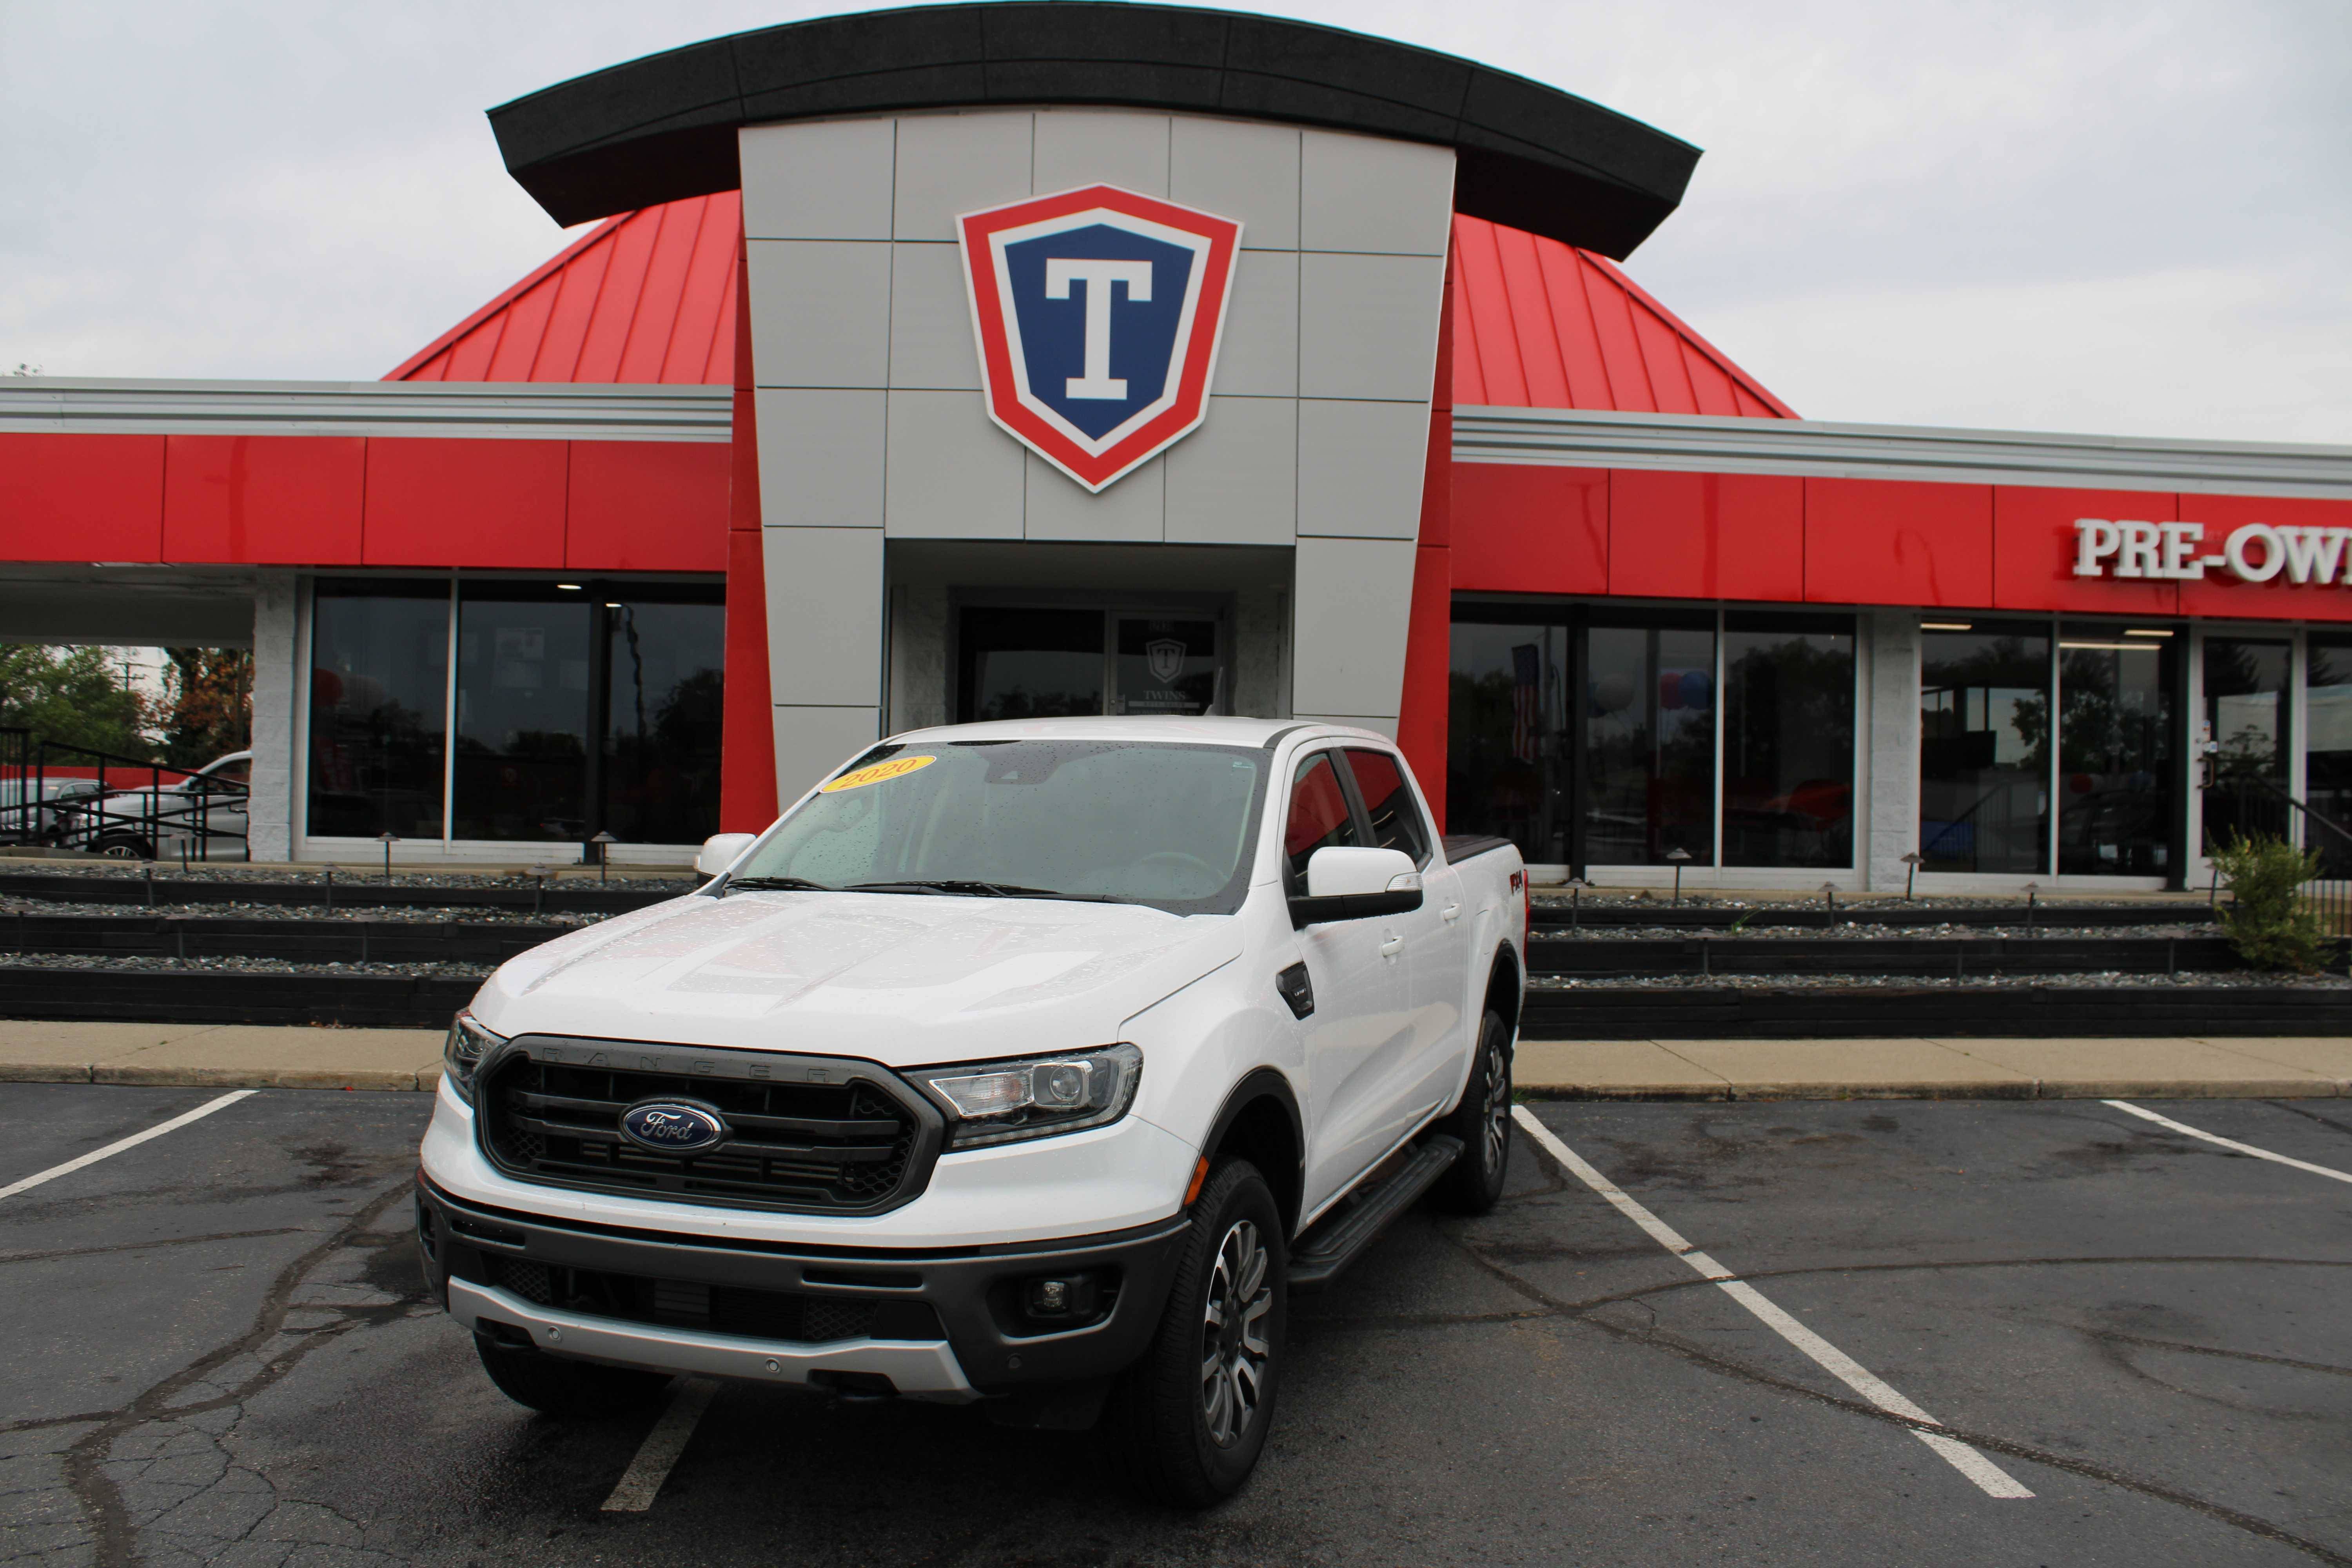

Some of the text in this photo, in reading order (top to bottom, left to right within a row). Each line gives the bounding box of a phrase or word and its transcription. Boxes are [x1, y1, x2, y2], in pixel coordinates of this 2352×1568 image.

[1045, 258, 1152, 400] T
[2073, 518, 2352, 585] PRE-OW
[1157, 648, 1176, 669] T
[1143, 690, 1186, 700] TWINS
[838, 759, 917, 789] 2020
[543, 1047, 831, 1083] RANGER
[640, 1111, 694, 1140] Ford
